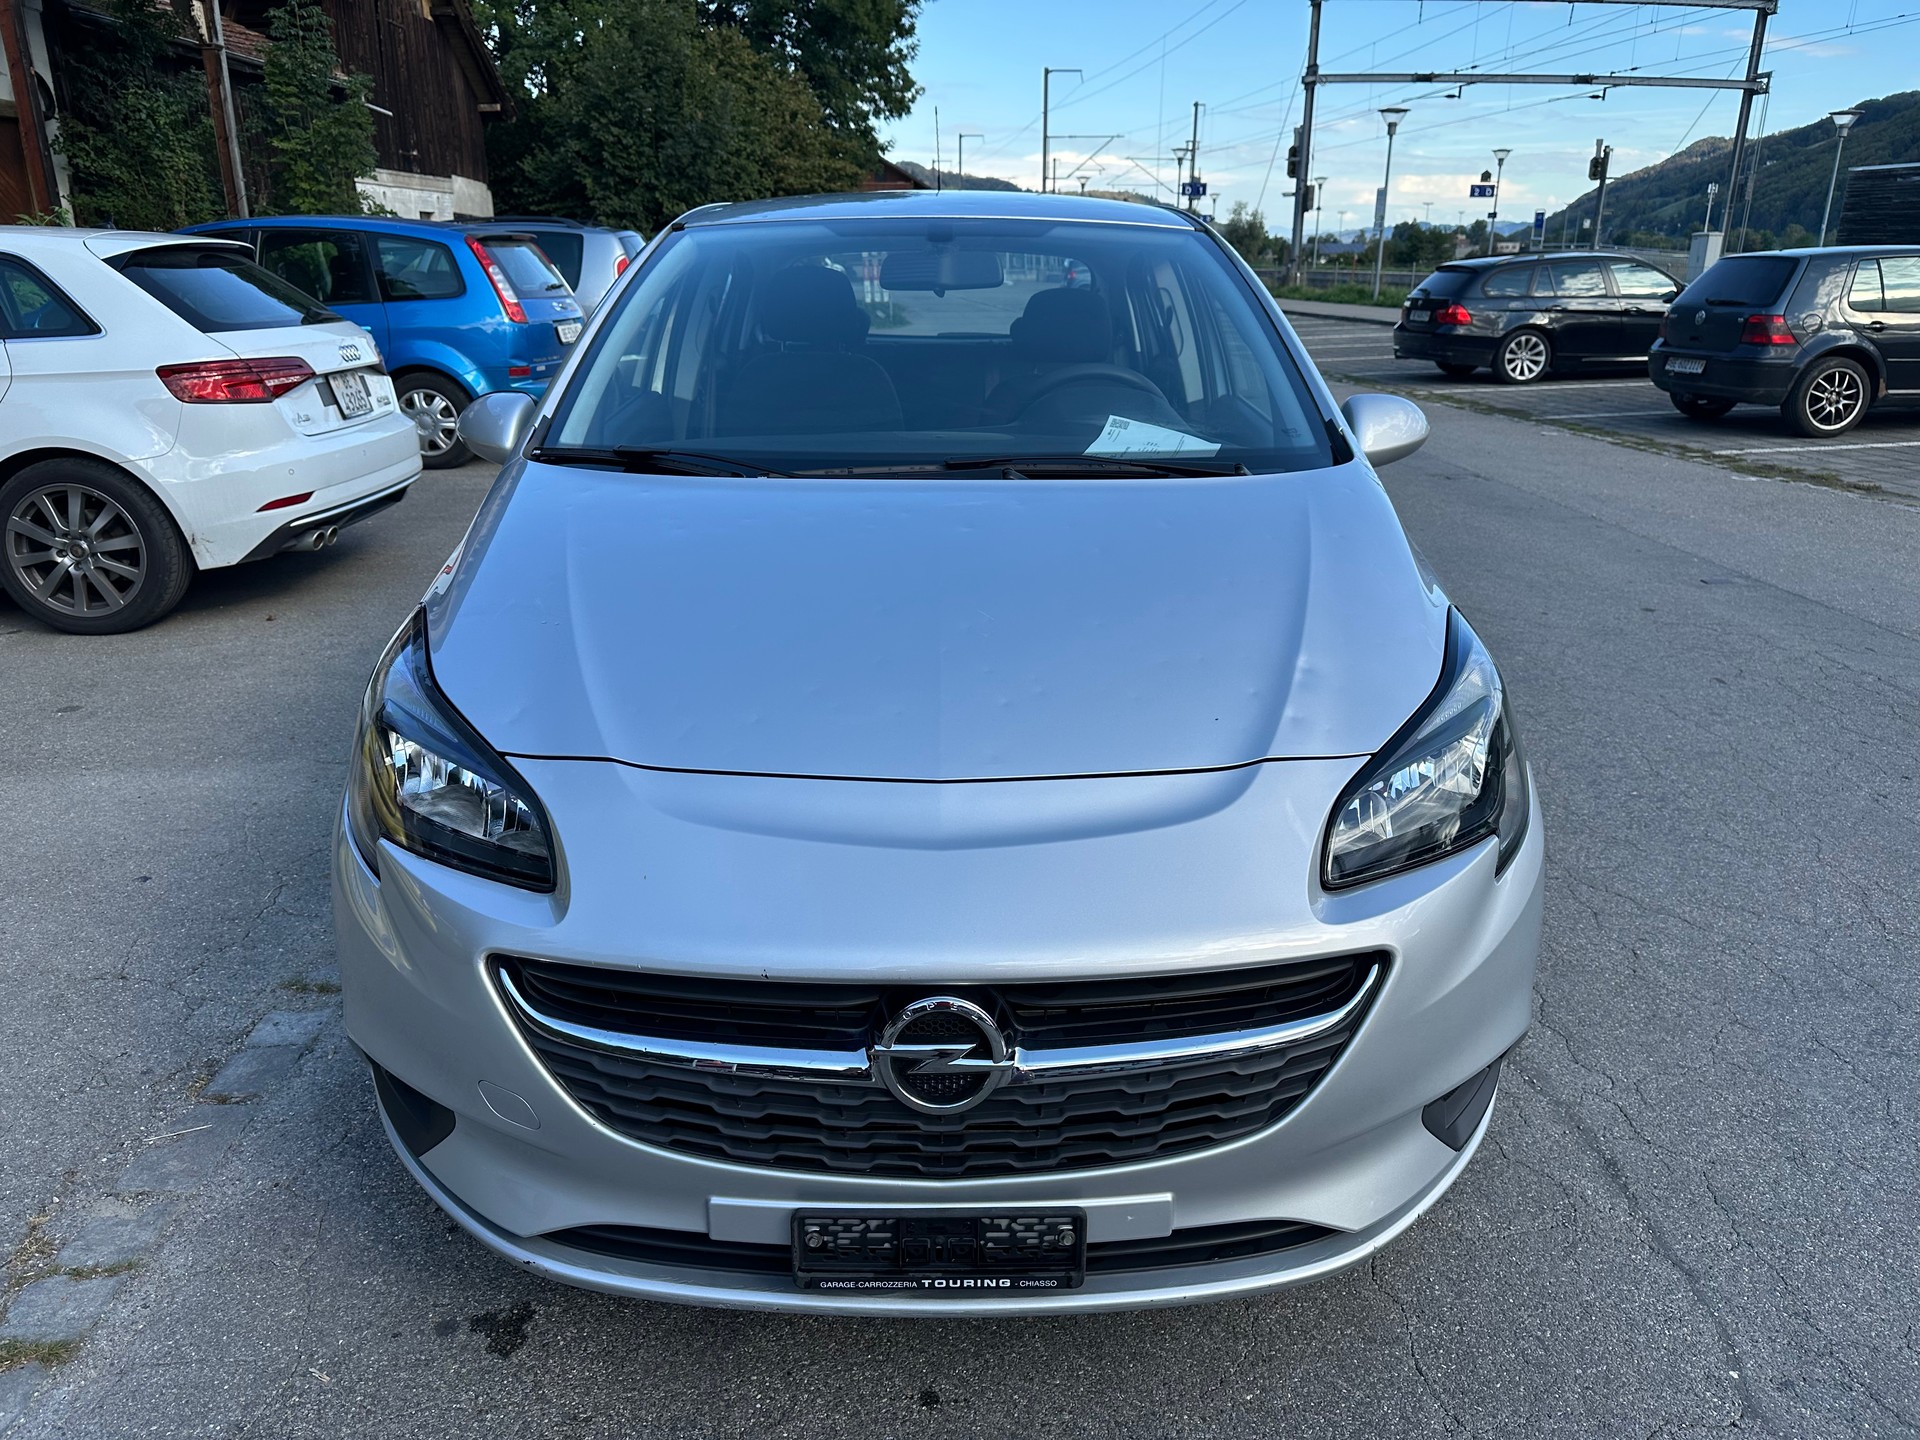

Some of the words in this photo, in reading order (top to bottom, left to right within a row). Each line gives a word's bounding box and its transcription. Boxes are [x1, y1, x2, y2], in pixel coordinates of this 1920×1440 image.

[1473, 187, 1480, 196] 2
[902, 1001, 980, 1021] OPEL
[820, 1281, 918, 1289] GARAGE-CARROZZERIA
[921, 1279, 1011, 1288] TOURING
